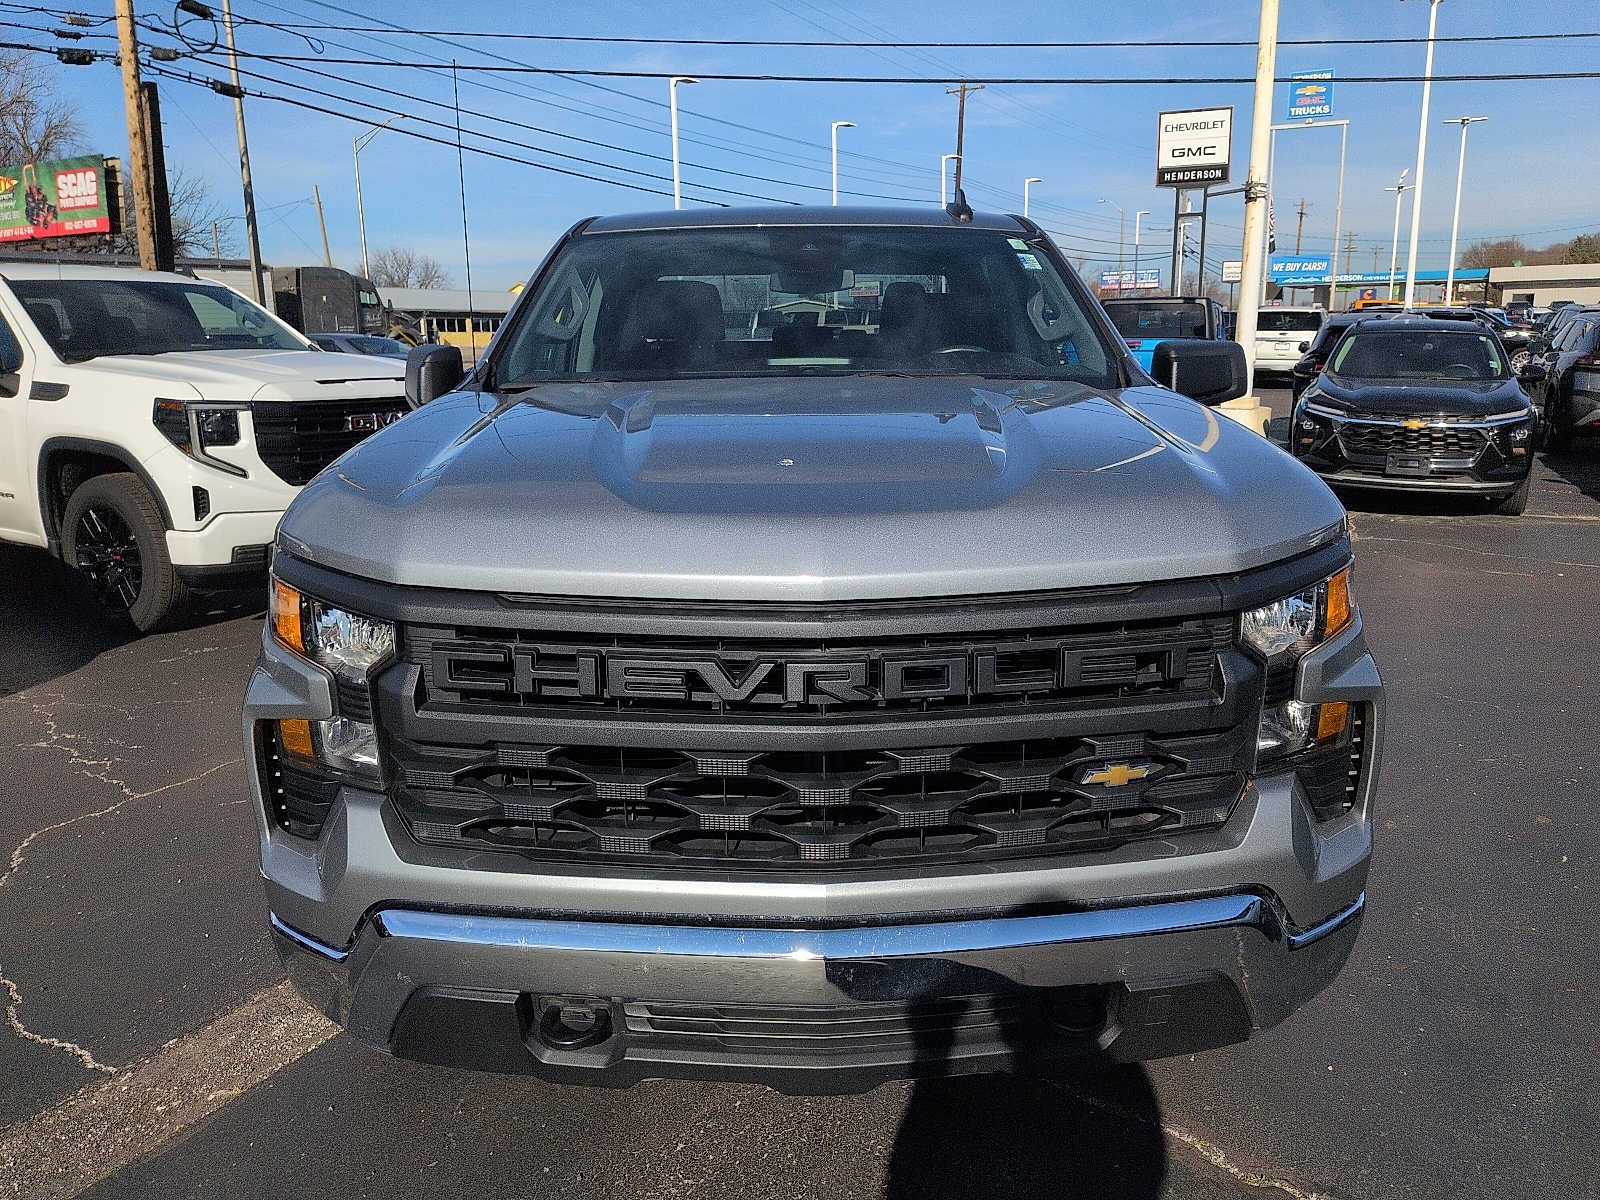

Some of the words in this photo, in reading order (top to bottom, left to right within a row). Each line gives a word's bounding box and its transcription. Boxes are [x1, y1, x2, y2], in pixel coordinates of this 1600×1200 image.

[1290, 105, 1330, 116] TRUCKS
[1164, 120, 1226, 133] CHEVROLET
[1171, 145, 1217, 158] GMC
[1164, 169, 1222, 181] HENDERSON
[57, 171, 97, 198] SCAG
[1272, 263, 1285, 272] WE
[1285, 262, 1301, 271] BUY
[1301, 261, 1328, 271] CARS!!
[349, 410, 403, 431] GM
[429, 641, 1208, 706] CHEVROLET
